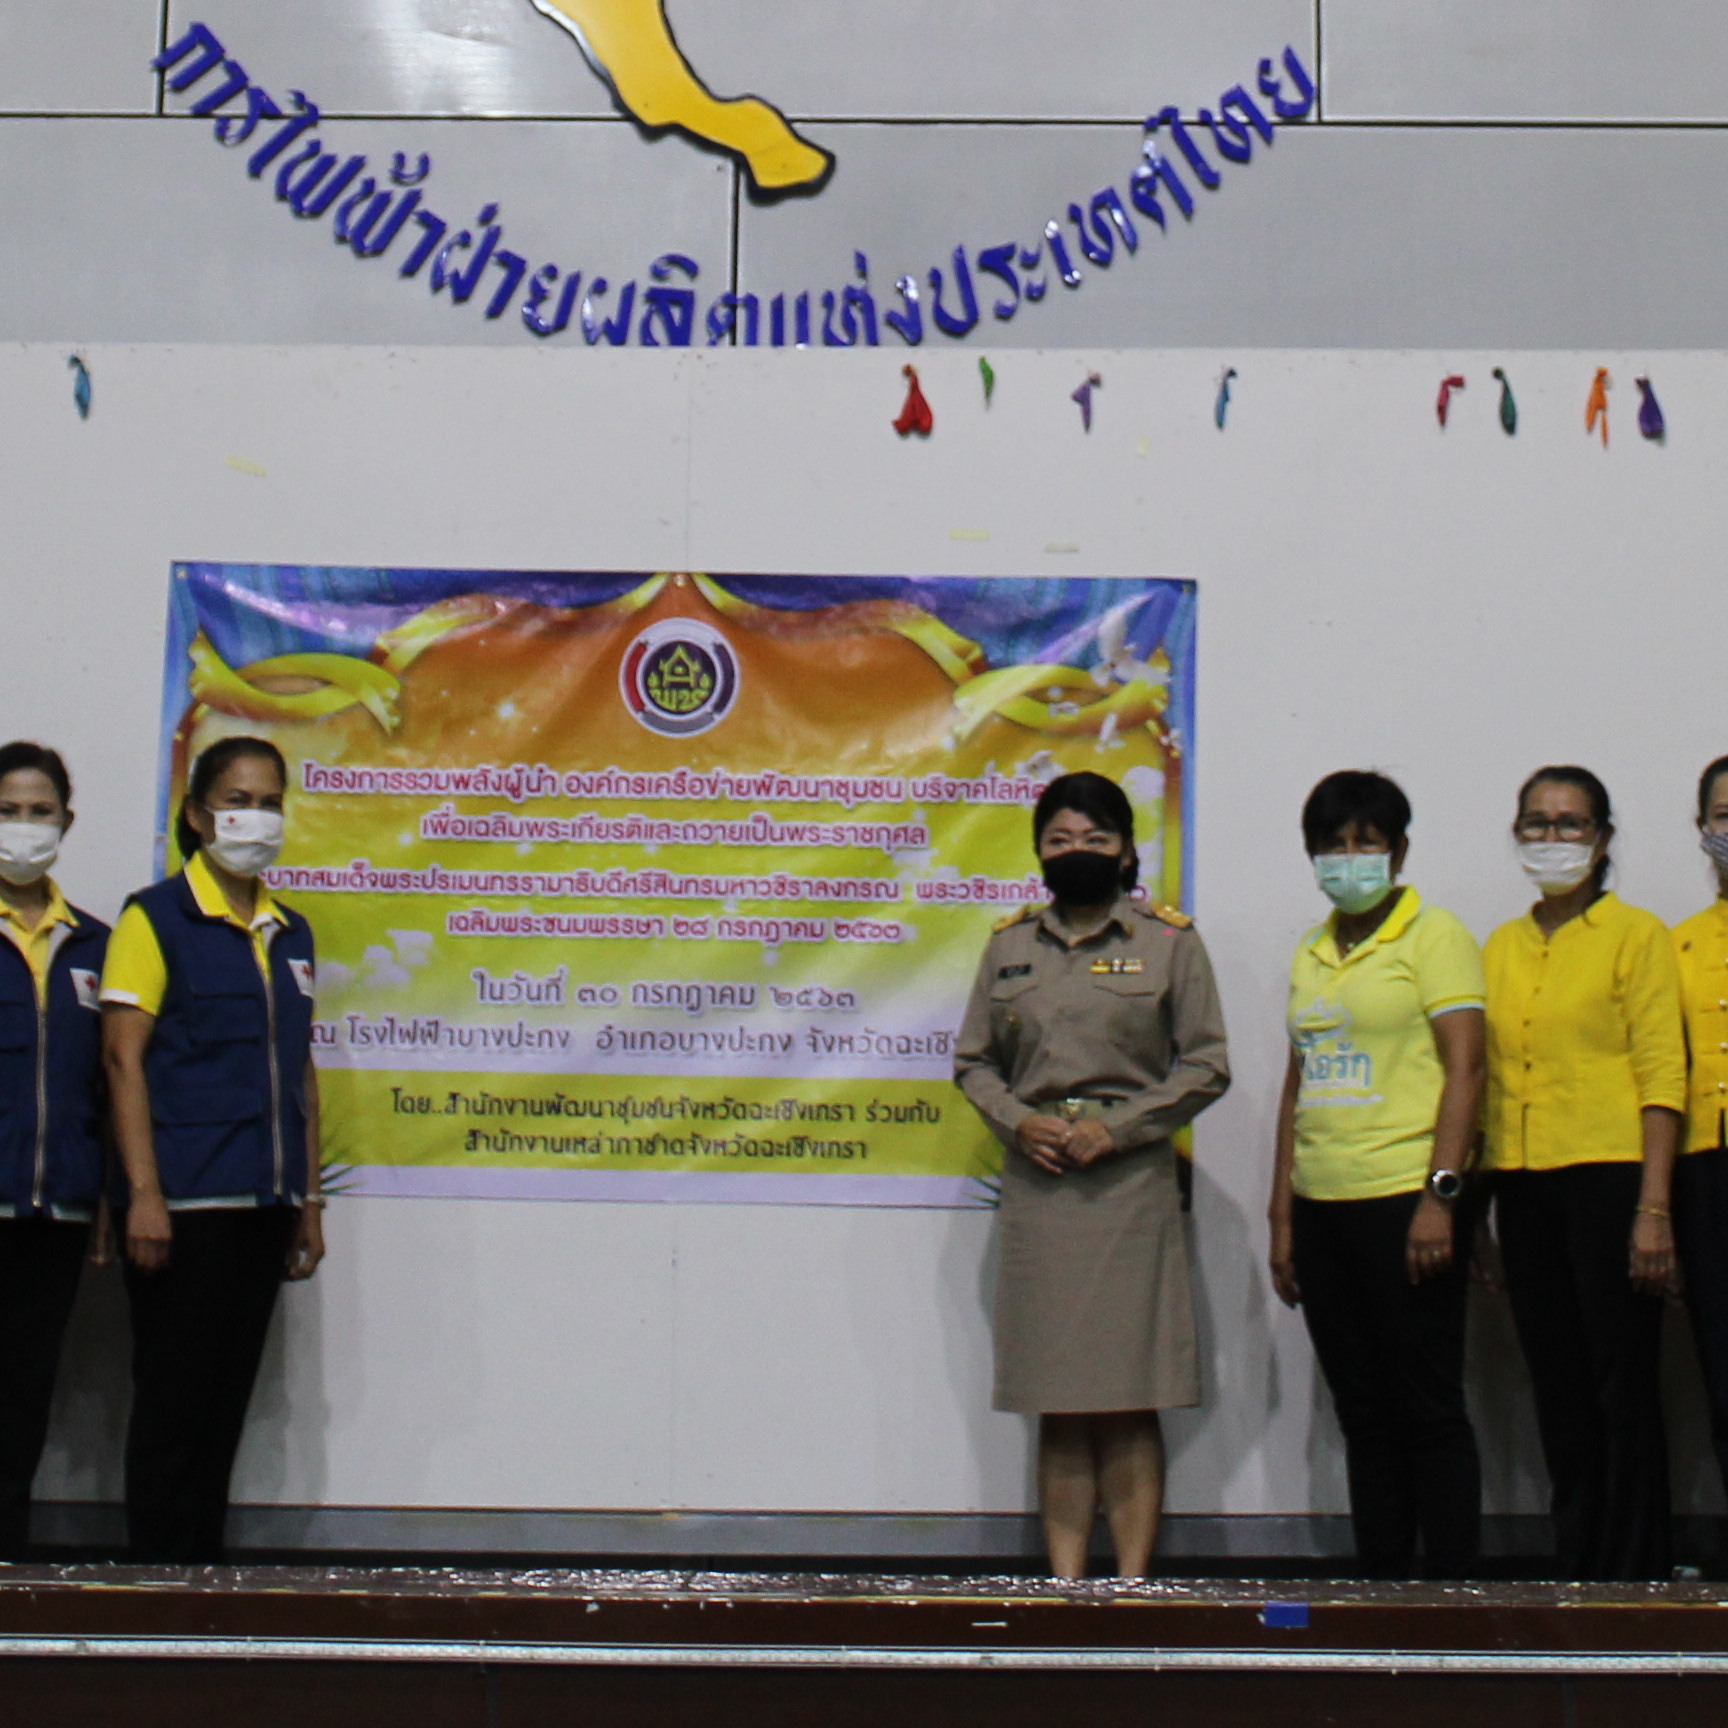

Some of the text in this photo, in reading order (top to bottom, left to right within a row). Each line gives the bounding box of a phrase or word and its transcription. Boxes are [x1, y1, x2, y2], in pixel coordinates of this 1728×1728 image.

[303, 762, 556, 799] โครงการรวมพลังผู้นำ
[566, 770, 902, 804] องค์กรเครือข่ายพัฒนาชุมชน
[422, 804, 925, 851] เพื่อเฉลิมพระเกียรติและถวายเป็นพระราชกุศล
[448, 909, 664, 935] เฉลิมพระชนมพรรษา
[673, 918, 709, 936] ๒๘
[718, 920, 824, 943] กรกฎาคม
[472, 968, 855, 1012] ในวันที่ ๓๐ กรกฎาคม ๒๕๖๓
[596, 1025, 793, 1053] อำเภอบางปะกง
[806, 1027, 957, 1056] จังหวัดฉะเชิ
[866, 1098, 941, 1123] ร่วมกับ
[465, 1127, 868, 1159] สำนักงานเหล่ากาชาดจังหวัดฉะเชิงเทรา
